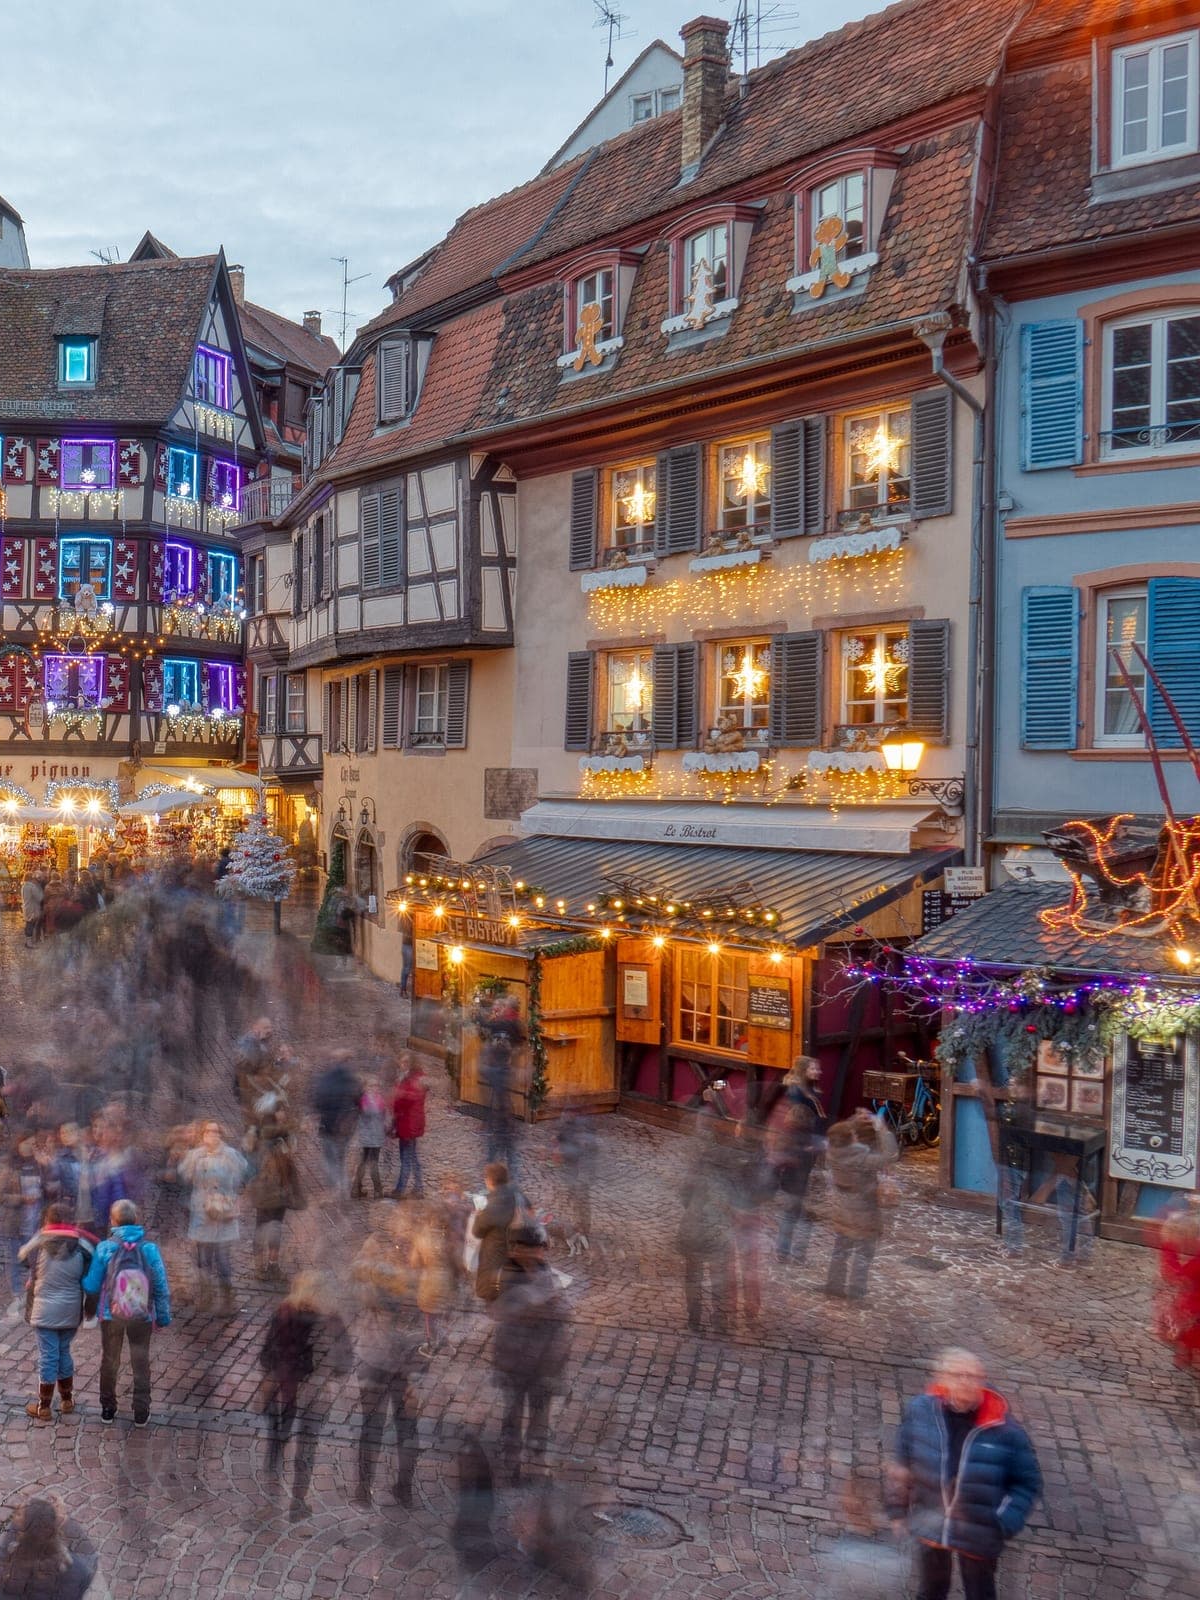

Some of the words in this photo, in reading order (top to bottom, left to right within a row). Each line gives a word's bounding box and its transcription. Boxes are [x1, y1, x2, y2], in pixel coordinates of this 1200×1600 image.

[30, 760, 90, 782] pignon
[664, 824, 676, 837] Le
[680, 824, 717, 838] Bistrot
[448, 916, 464, 937] LE
